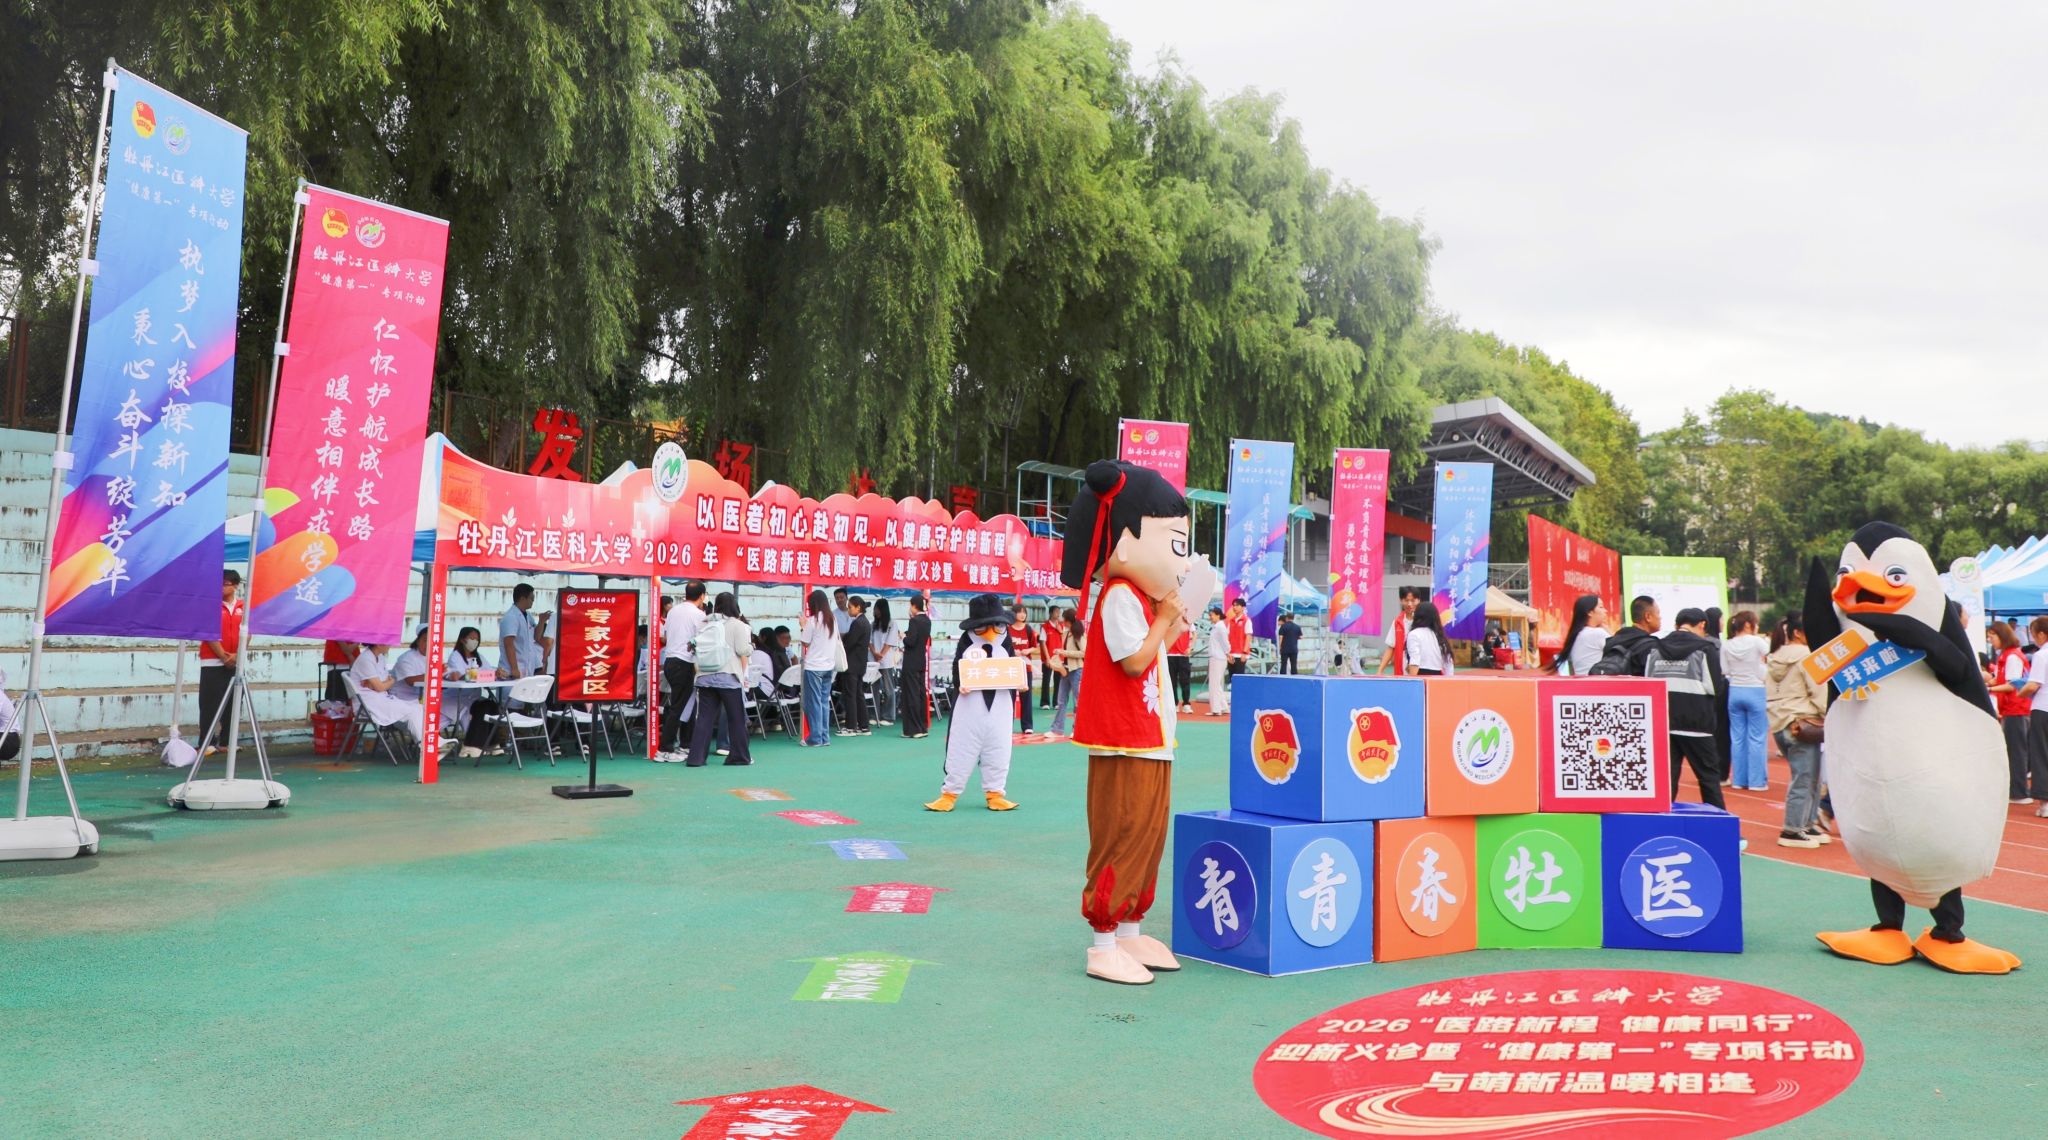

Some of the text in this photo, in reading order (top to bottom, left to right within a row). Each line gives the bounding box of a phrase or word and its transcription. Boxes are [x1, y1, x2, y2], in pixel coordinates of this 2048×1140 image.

[313, 245, 432, 286] 牡丹江医科大学
[92, 308, 160, 597] 秉心奋斗绽芳华
[347, 316, 401, 543] 仁怀护航成长路
[527, 406, 584, 482] 发
[294, 375, 353, 606] 暖意相伴求学途
[458, 520, 632, 565] 牡丹江医科大学
[643, 541, 691, 566] 2026
[583, 608, 612, 695] 专家义诊区
[1195, 857, 1239, 935] 青
[1299, 847, 1703, 931] 青 春 牡 医
[1416, 986, 1723, 1006] 牡丹江医科大学
[1422, 1072, 1757, 1094] 与萌新温暖相逢
[726, 1108, 816, 1140] 专家
